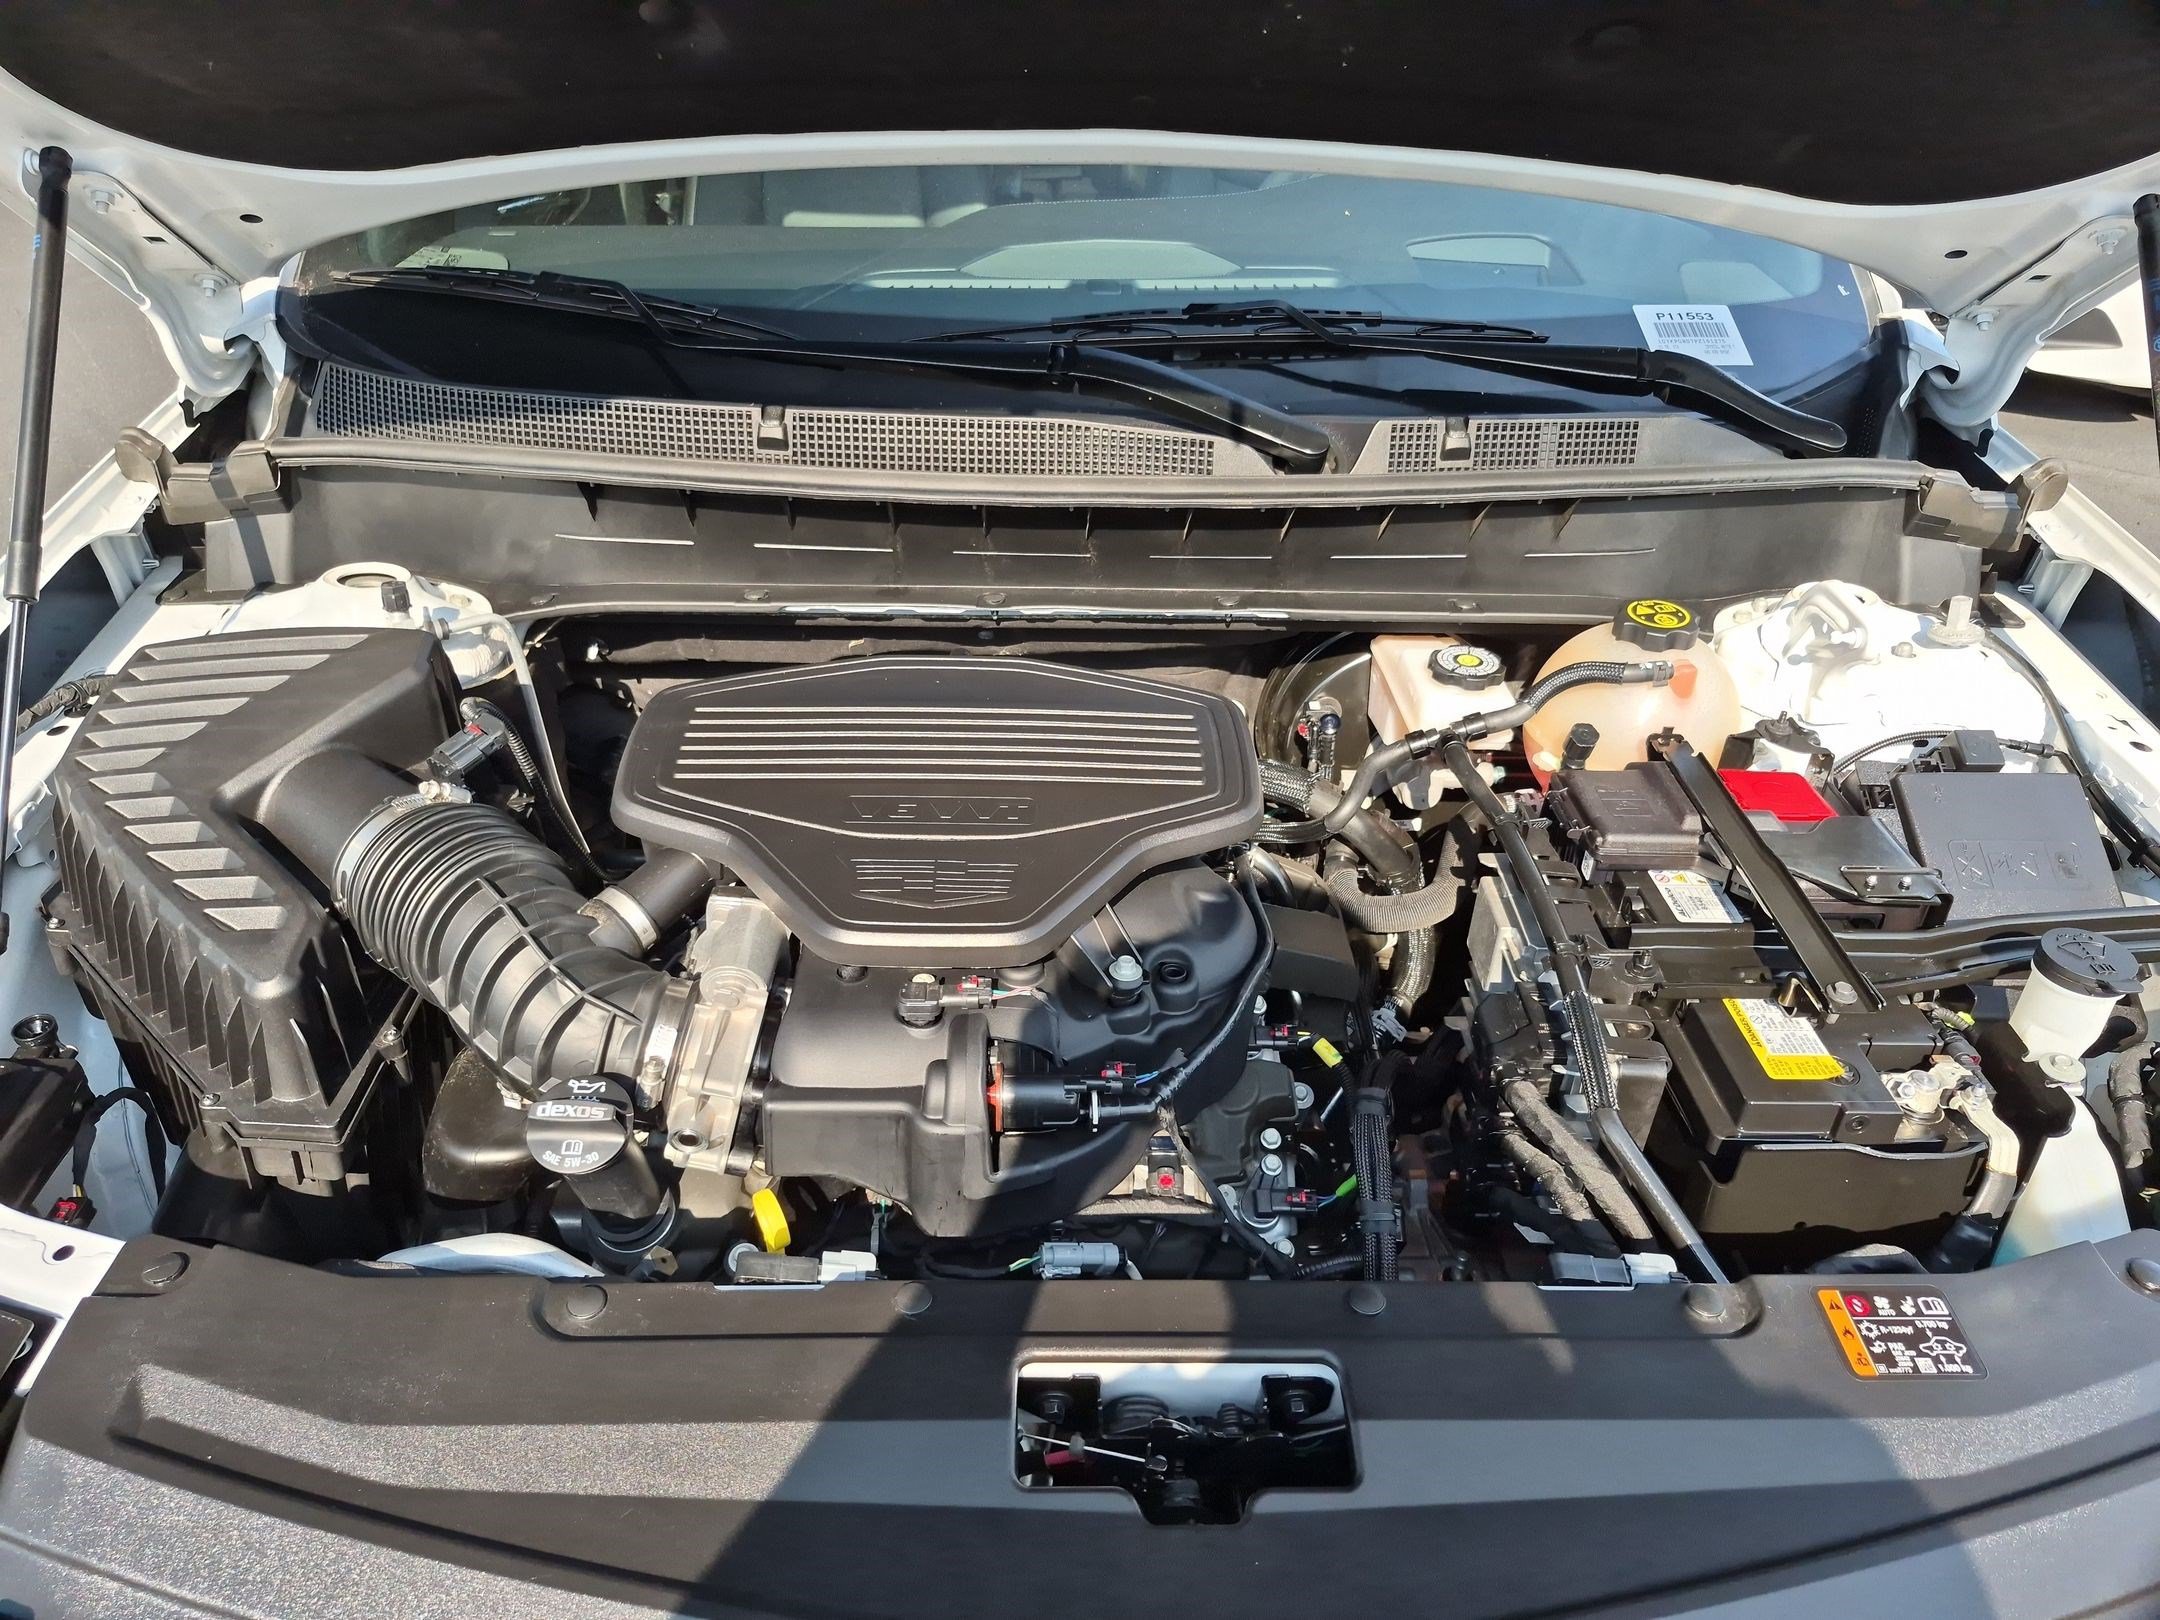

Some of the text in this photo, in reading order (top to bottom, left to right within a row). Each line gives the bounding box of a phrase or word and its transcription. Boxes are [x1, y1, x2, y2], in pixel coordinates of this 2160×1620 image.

[1656, 312, 1714, 321] P11553
[536, 1101, 608, 1119] dexos
[542, 1150, 599, 1168] SAE 5W-30
